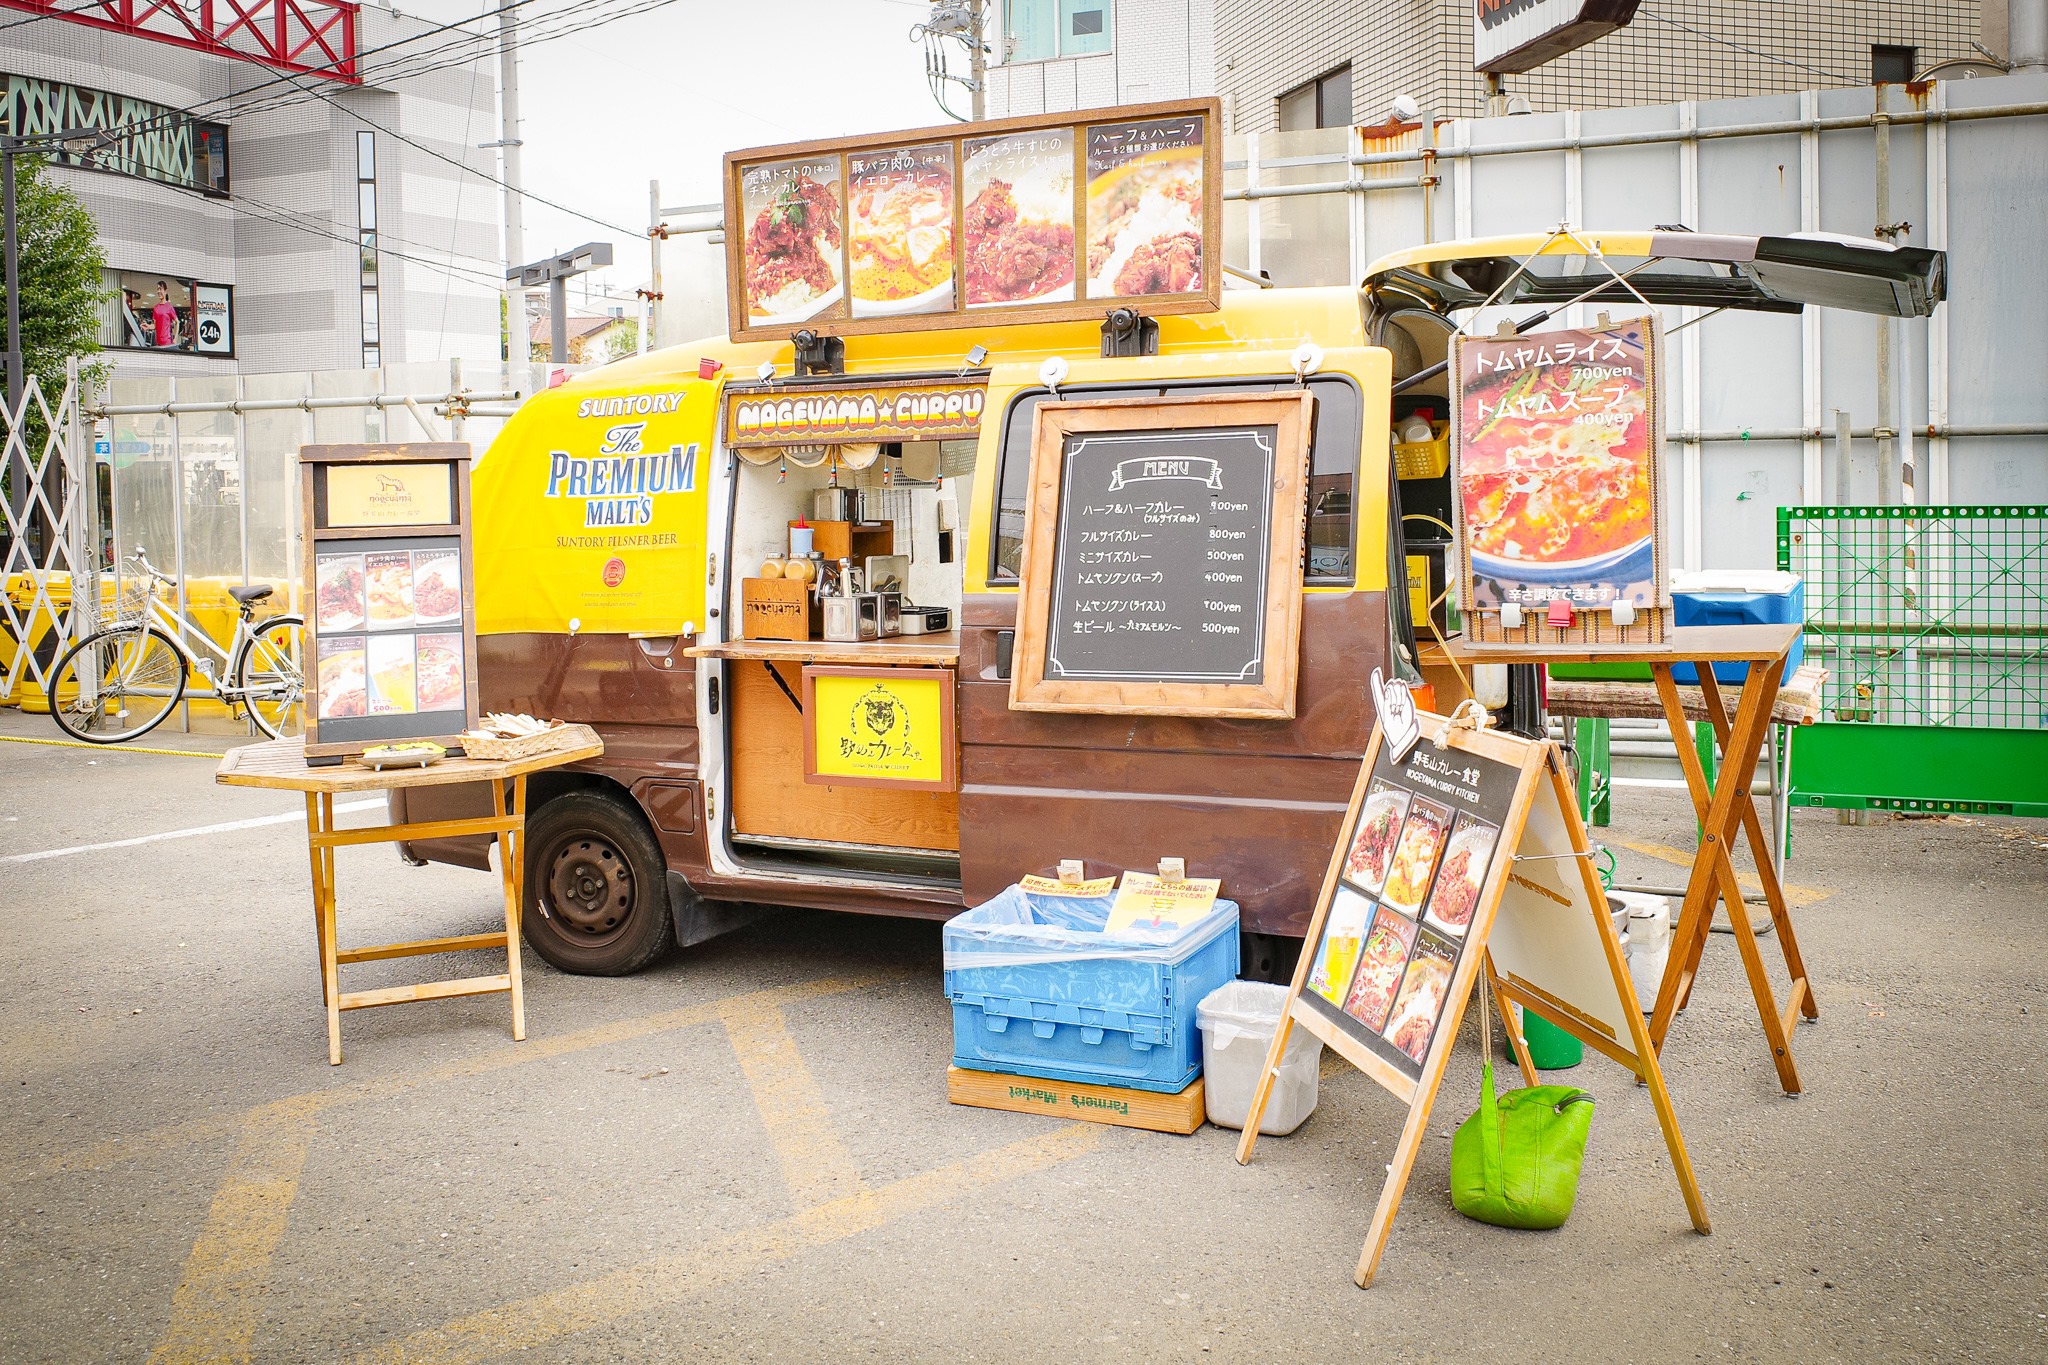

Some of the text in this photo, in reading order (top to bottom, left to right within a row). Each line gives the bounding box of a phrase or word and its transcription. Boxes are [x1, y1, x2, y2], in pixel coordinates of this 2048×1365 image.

[970, 138, 1062, 159] とろとろ牛すじの
[854, 171, 939, 188] イエローカレー
[201, 325, 220, 338] 24h
[1476, 338, 1628, 374] トムヤムライス
[1572, 366, 1633, 381] 700yen
[578, 392, 687, 418] SUNTORY
[896, 393, 982, 426] CURRY
[1477, 384, 1630, 420] トムヤムスープ
[1575, 411, 1634, 426] 400yen
[600, 422, 646, 454] The
[545, 445, 698, 496] PREMIUM
[1143, 460, 1190, 476] MENU
[586, 497, 651, 526] MALT'S
[1211, 501, 1248, 511] 900yen
[557, 533, 678, 548] SUNTORY PILSNER BEER
[1081, 529, 1246, 543] フルサイズカレー 800yen
[1079, 550, 1244, 564] ミニサイズカレー 500yen
[1204, 573, 1243, 583] 400yen
[1203, 600, 1241, 612] 700yen
[1072, 620, 1115, 633] 生ビール
[1202, 623, 1240, 634] 500yen
[1406, 768, 1480, 803] NOGEYAMA CURRY KITCHEN
[1009, 1086, 1128, 1115] Farmer's Market
